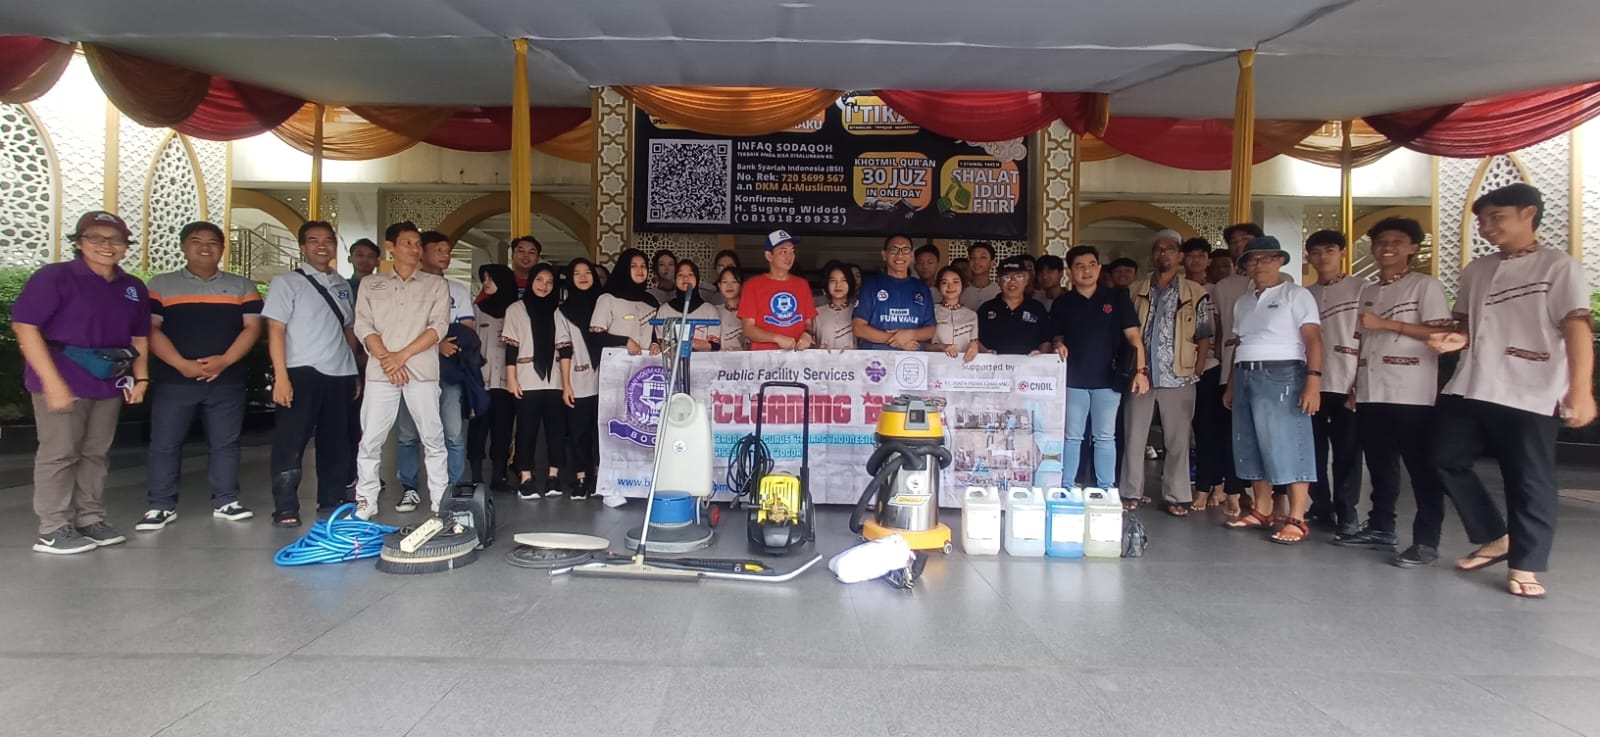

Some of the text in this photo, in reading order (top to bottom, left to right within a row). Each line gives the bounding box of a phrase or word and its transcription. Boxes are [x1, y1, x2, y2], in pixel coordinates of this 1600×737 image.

[737, 141, 833, 153] INFAQ SODAQOH
[736, 163, 756, 171] Bank
[757, 163, 786, 173] Syariah
[854, 158, 936, 168] KHOTMIL QUR'AN
[736, 172, 845, 183] No. Rek: 720 5699 567
[862, 168, 926, 188] 30 JUZ
[952, 169, 1019, 183] SHALAT
[736, 182, 848, 193] a.n DKM Al-Muslimun
[866, 188, 922, 198] IN ONE DAY
[974, 184, 1015, 198] IDUL
[734, 194, 795, 204] Konfirmasi:
[734, 204, 847, 215] H. Sugeng Widodo
[973, 200, 1015, 213] FITRI
[961, 363, 1015, 372] Supported by
[717, 369, 755, 381] Public
[757, 367, 800, 382] Facility
[803, 367, 855, 380] Services
[1030, 382, 1053, 391] CNOIL
